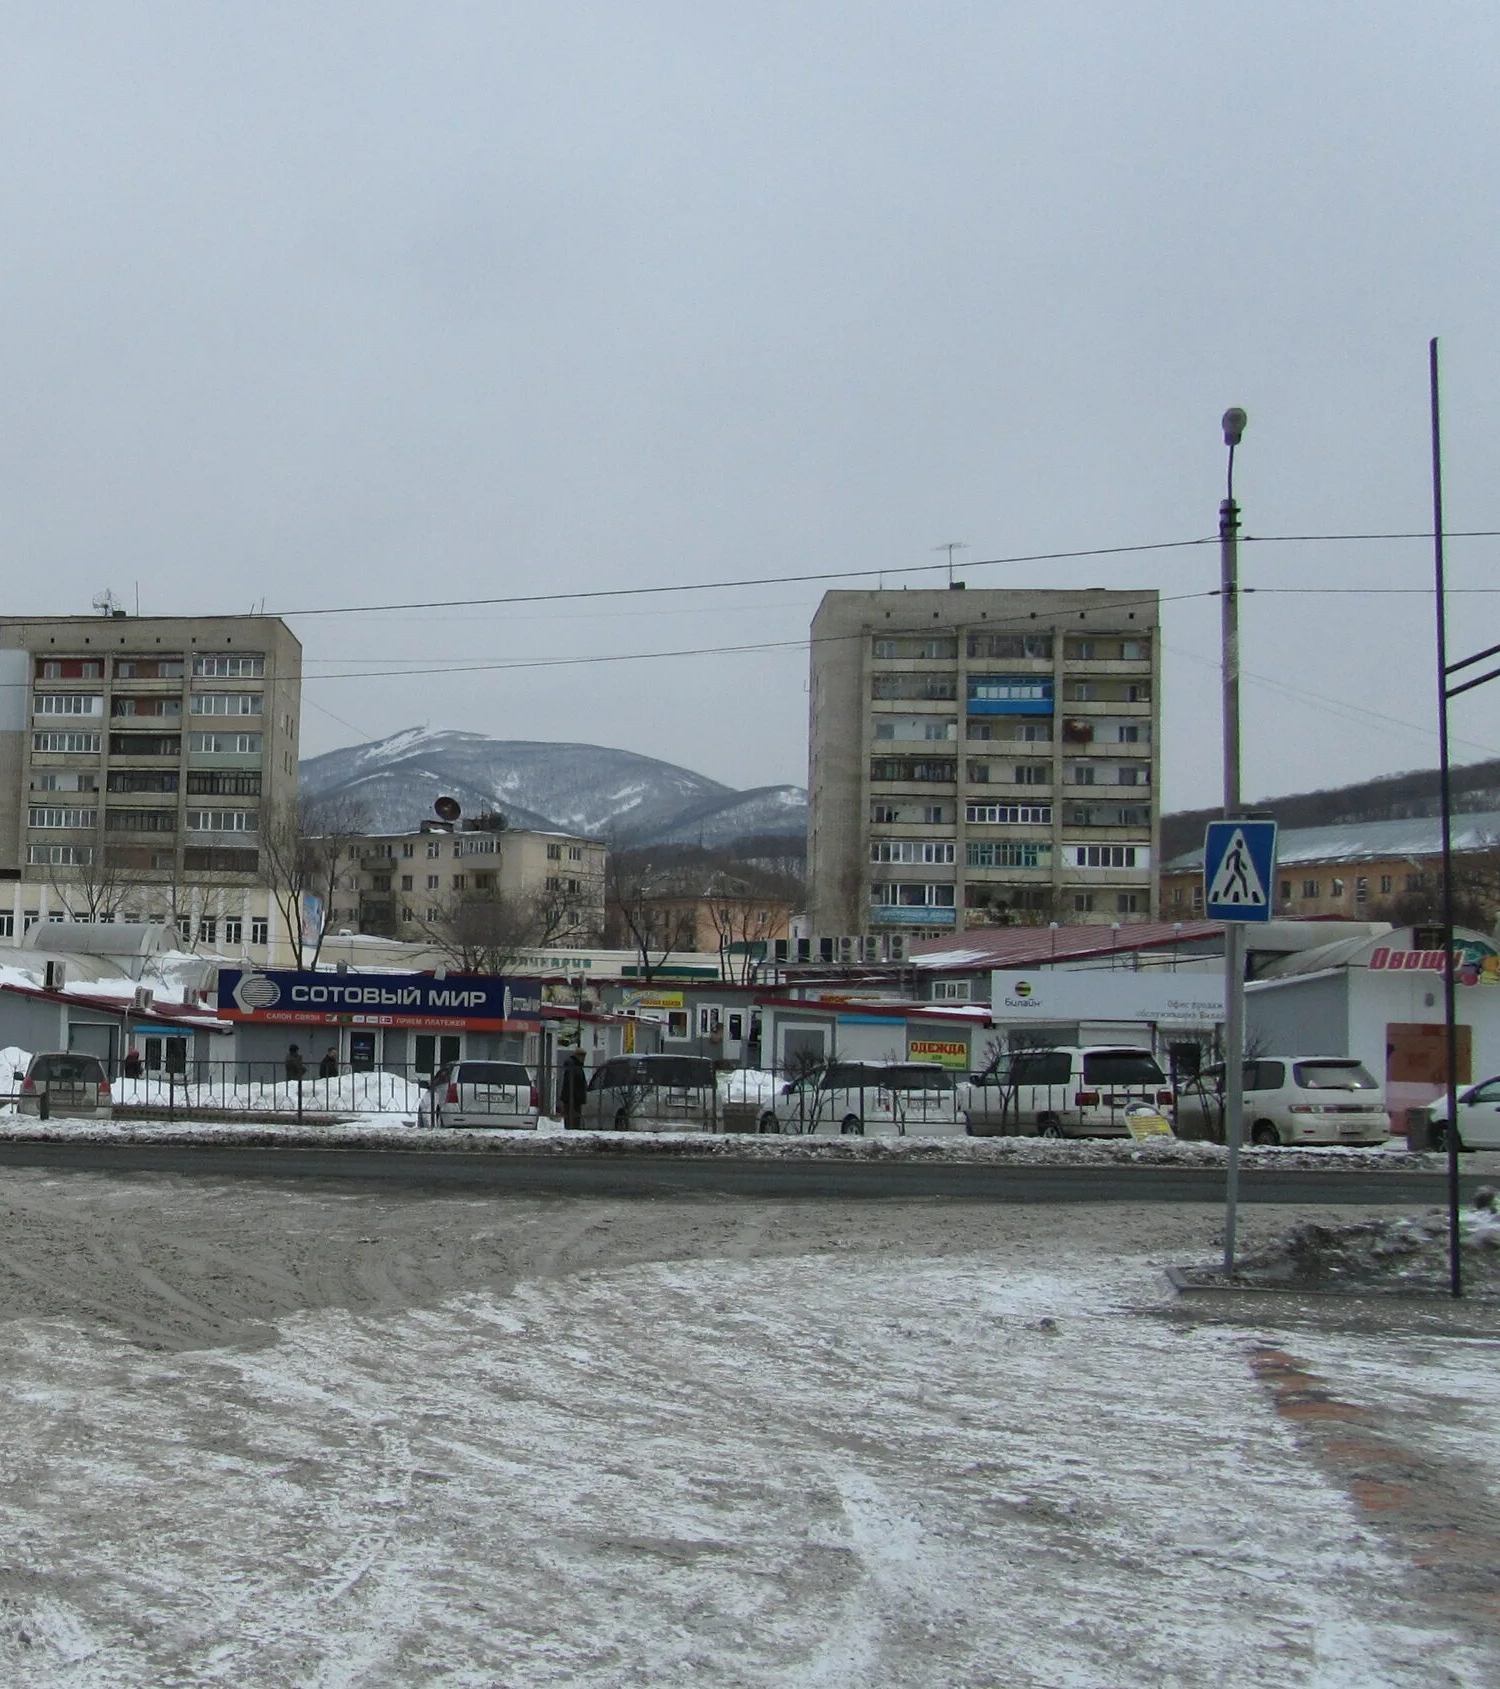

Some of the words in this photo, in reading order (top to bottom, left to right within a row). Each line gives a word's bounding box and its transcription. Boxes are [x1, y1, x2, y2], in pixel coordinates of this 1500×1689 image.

[291, 984, 422, 1006] СОТОВЫЙ
[428, 989, 487, 1008] МИР
[1004, 997, 1041, 1007] Билайн
[266, 1012, 292, 1020] САЛОН
[295, 1013, 320, 1021] СВЯЗИ
[424, 1018, 466, 1027] ПЛАТЕЖЕЙ
[910, 1042, 966, 1055] ОДЕЖДА
